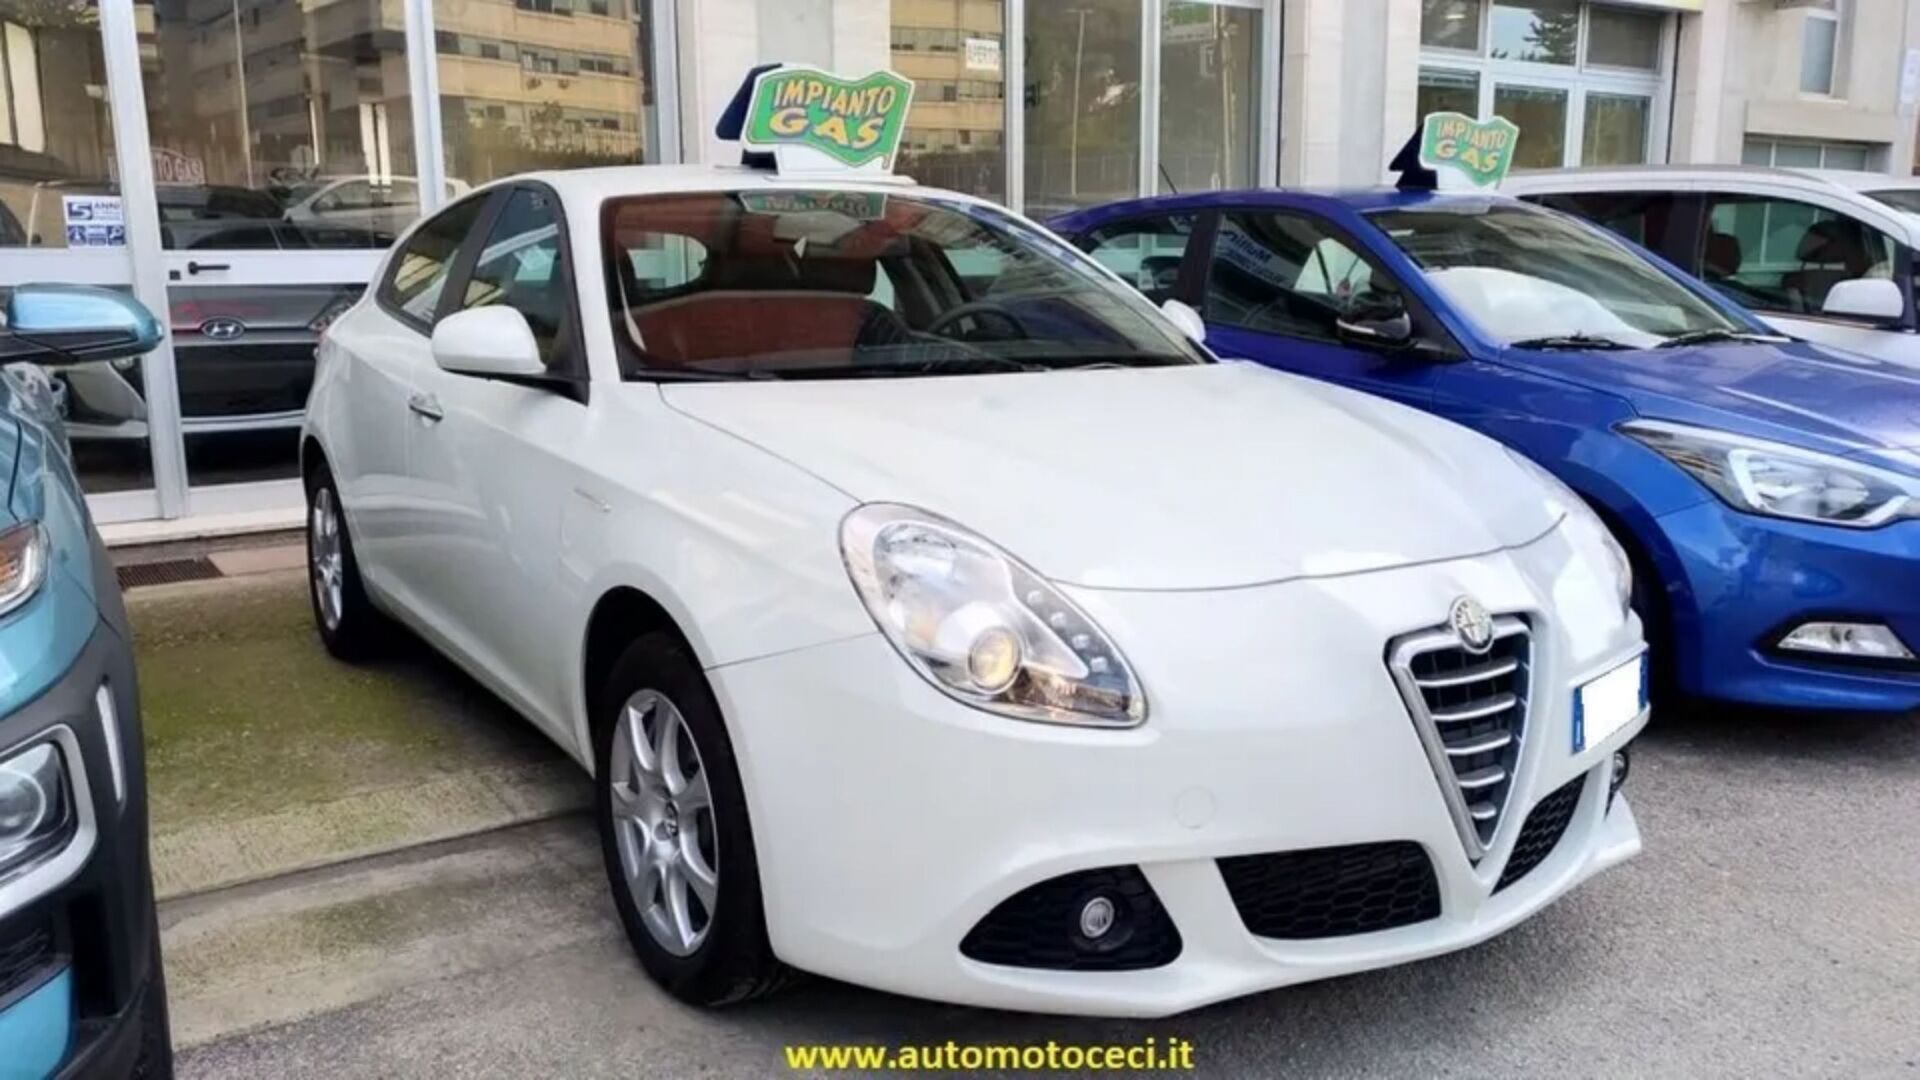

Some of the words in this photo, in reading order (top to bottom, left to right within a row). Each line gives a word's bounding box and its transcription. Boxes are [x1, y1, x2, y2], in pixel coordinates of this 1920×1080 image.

[774, 79, 896, 117] IMPIANTO
[769, 107, 885, 149] GAS
[1437, 119, 1507, 150] IMPIANTO
[1435, 138, 1501, 173] GAS
